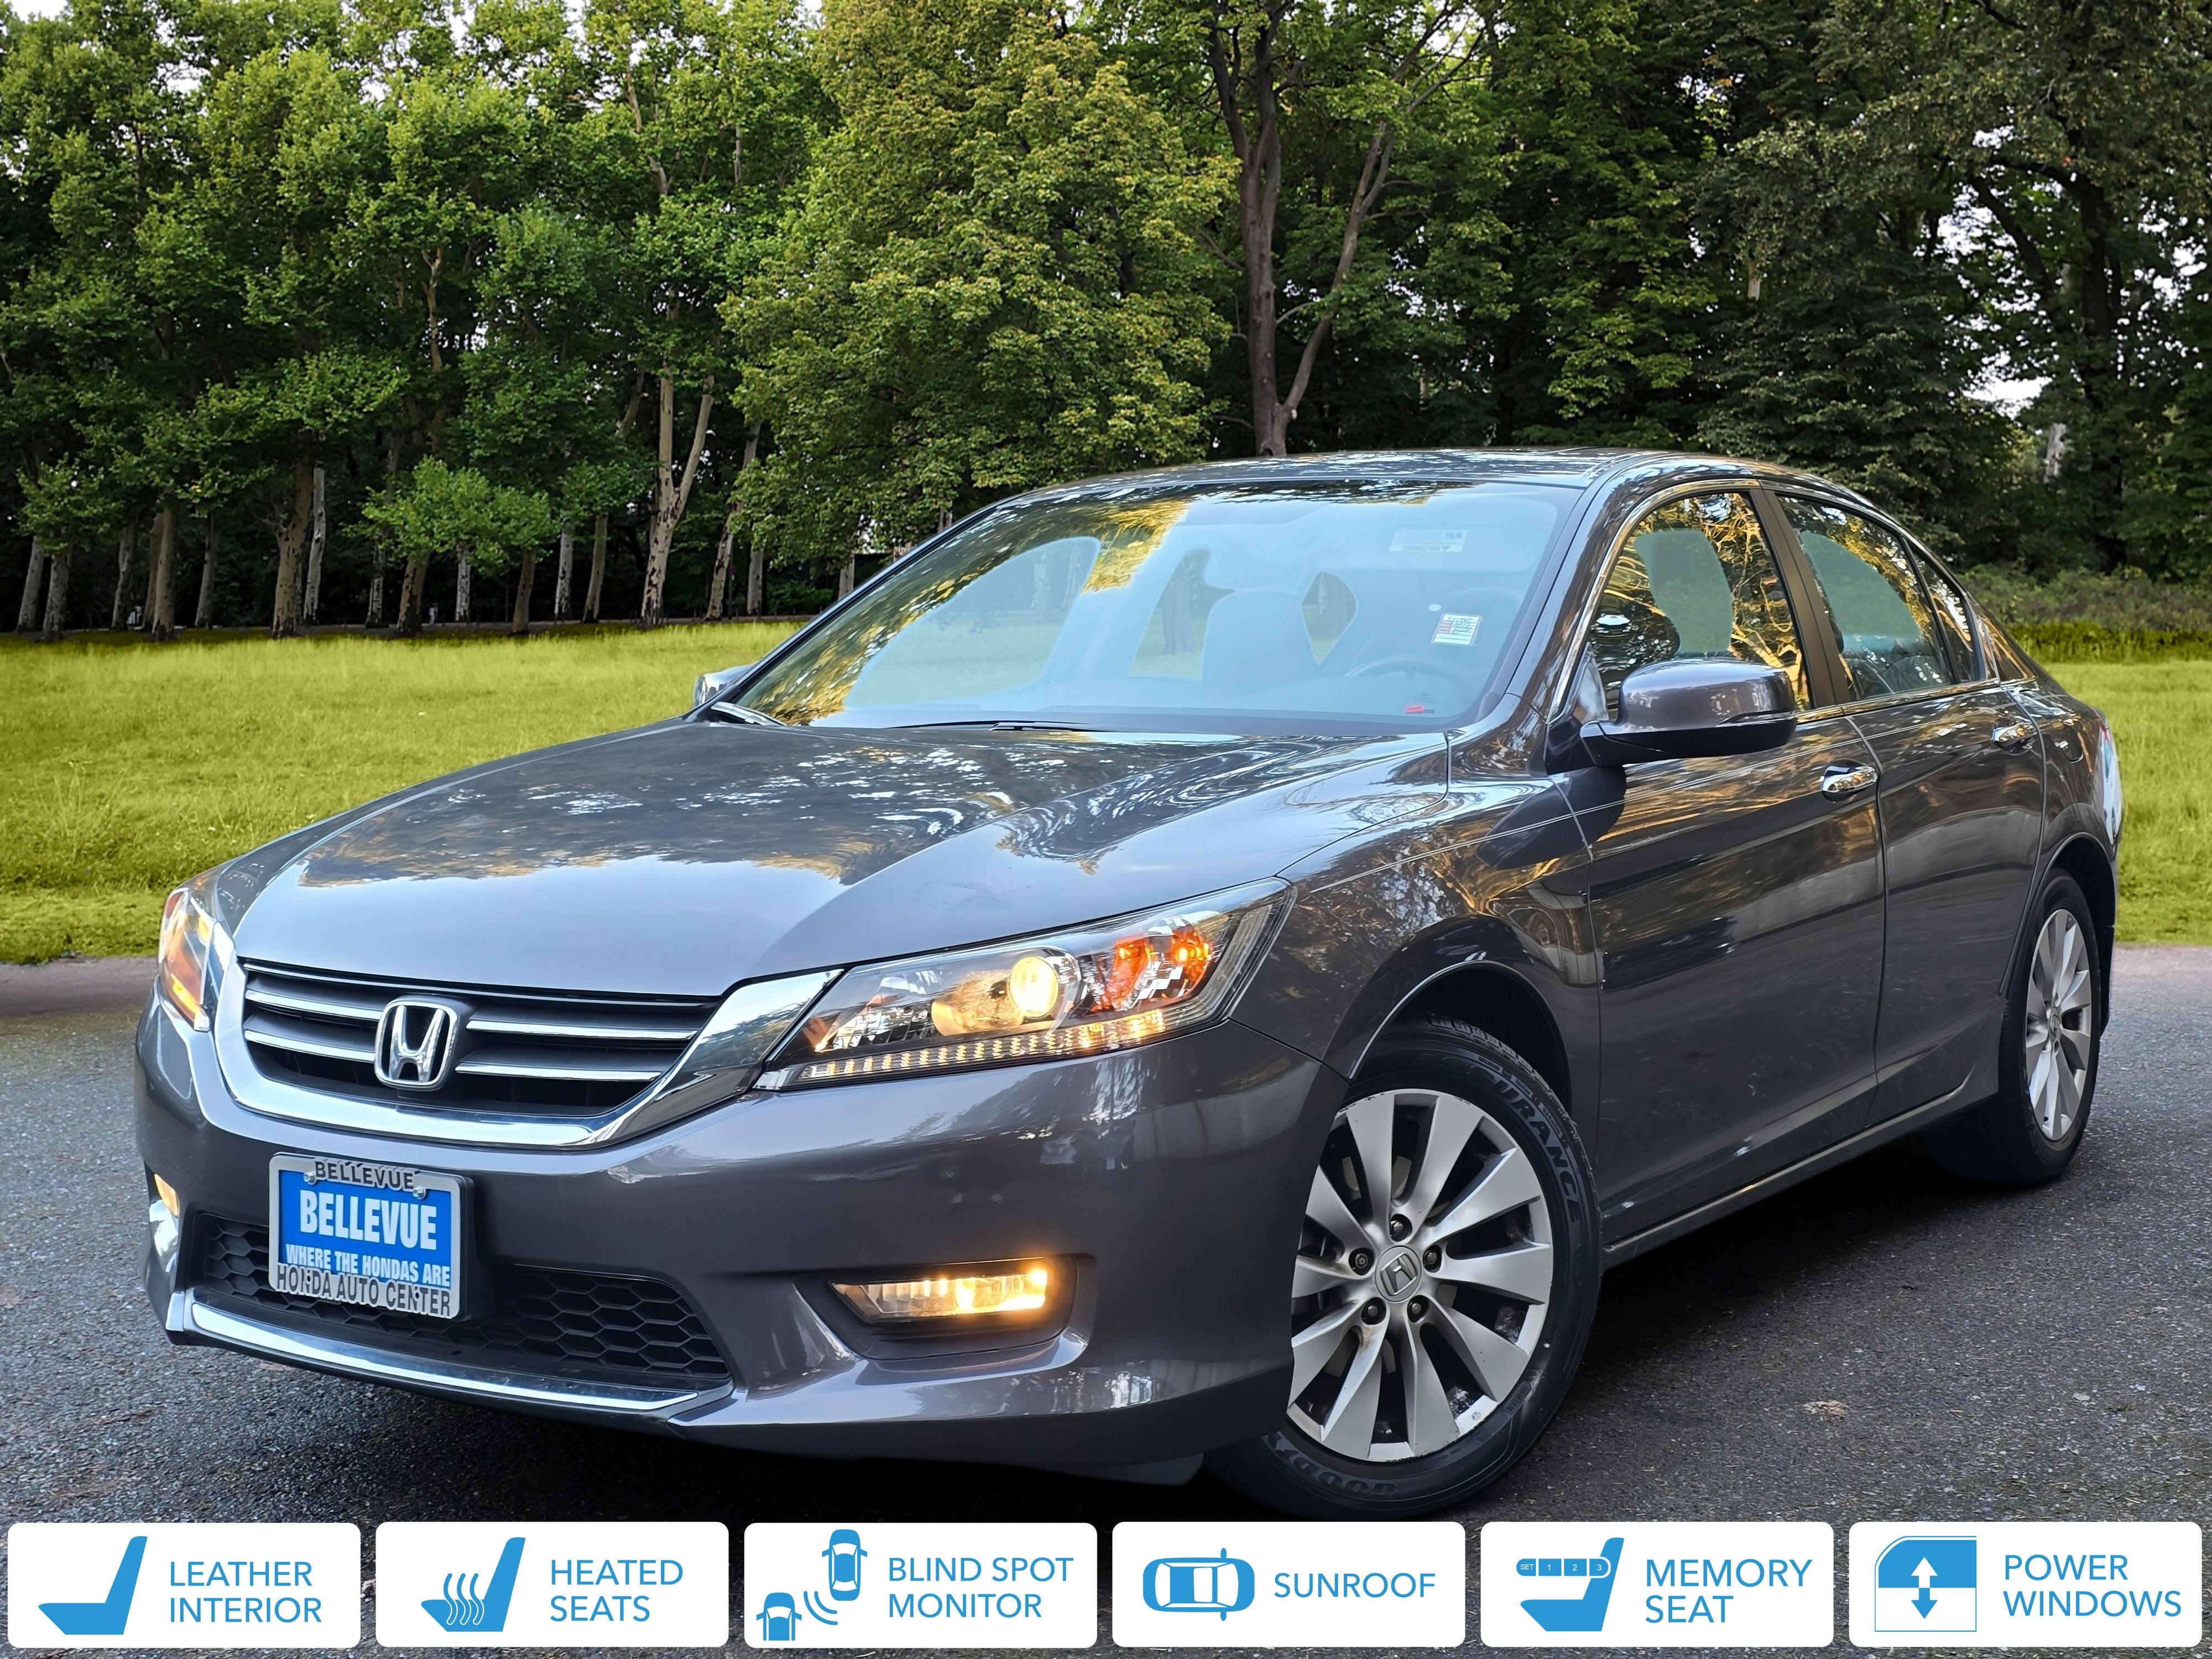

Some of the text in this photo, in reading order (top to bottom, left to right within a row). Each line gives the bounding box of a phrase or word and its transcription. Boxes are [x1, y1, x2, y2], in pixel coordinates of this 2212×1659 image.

[315, 1161, 414, 1190] BELLEVUE
[300, 1190, 437, 1250] BELLEVUE
[286, 1243, 451, 1287] WHERE THE HONDAS ARE
[277, 1265, 450, 1316] HONDA AUTO CENTER
